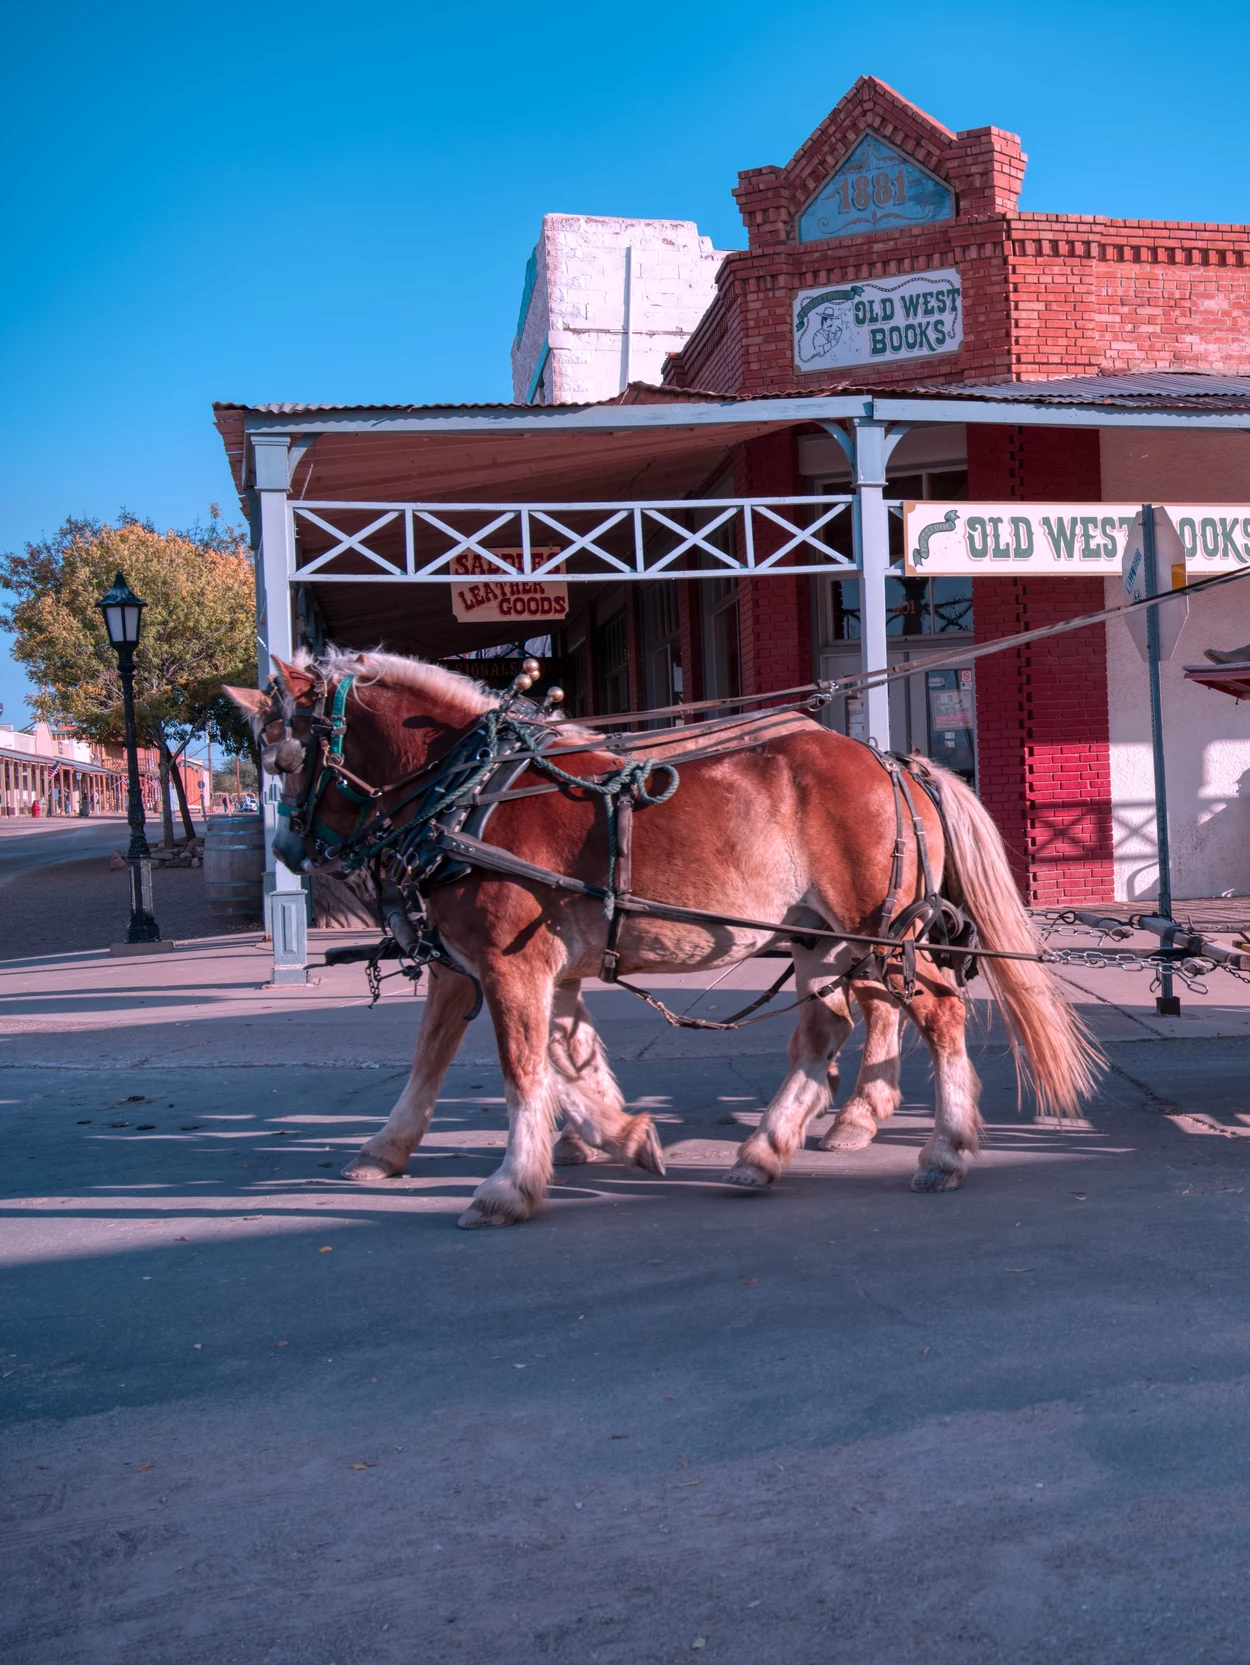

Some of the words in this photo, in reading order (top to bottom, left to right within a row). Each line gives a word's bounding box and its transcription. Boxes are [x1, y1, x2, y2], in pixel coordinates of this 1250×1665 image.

[837, 169, 907, 213] 1881
[853, 297, 895, 327] OLD
[900, 287, 961, 320] WEST
[869, 319, 947, 357] BOOKS
[963, 516, 1035, 562] OLD
[458, 581, 546, 612] LEATHER
[499, 595, 567, 616] GOODS
